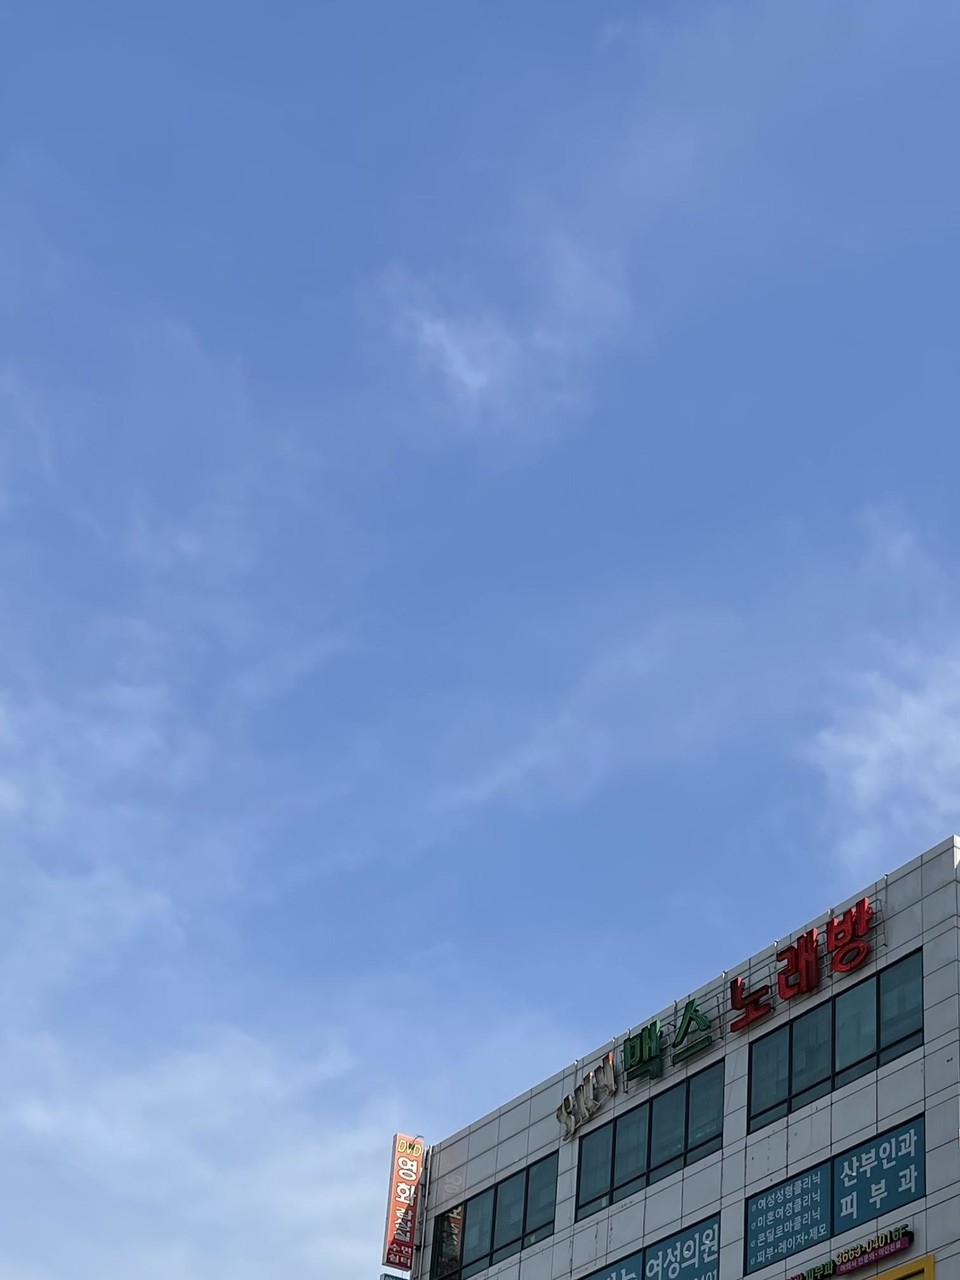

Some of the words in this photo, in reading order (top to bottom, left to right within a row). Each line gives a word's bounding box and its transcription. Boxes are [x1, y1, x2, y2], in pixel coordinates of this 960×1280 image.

[730, 896, 874, 1033] 노래방
[397, 1140, 422, 1157] DVD
[840, 1129, 917, 1188] 산부인과
[757, 1171, 821, 1210] 여성성형클리닉
[757, 1189, 821, 1228] 미혼여성클리닉
